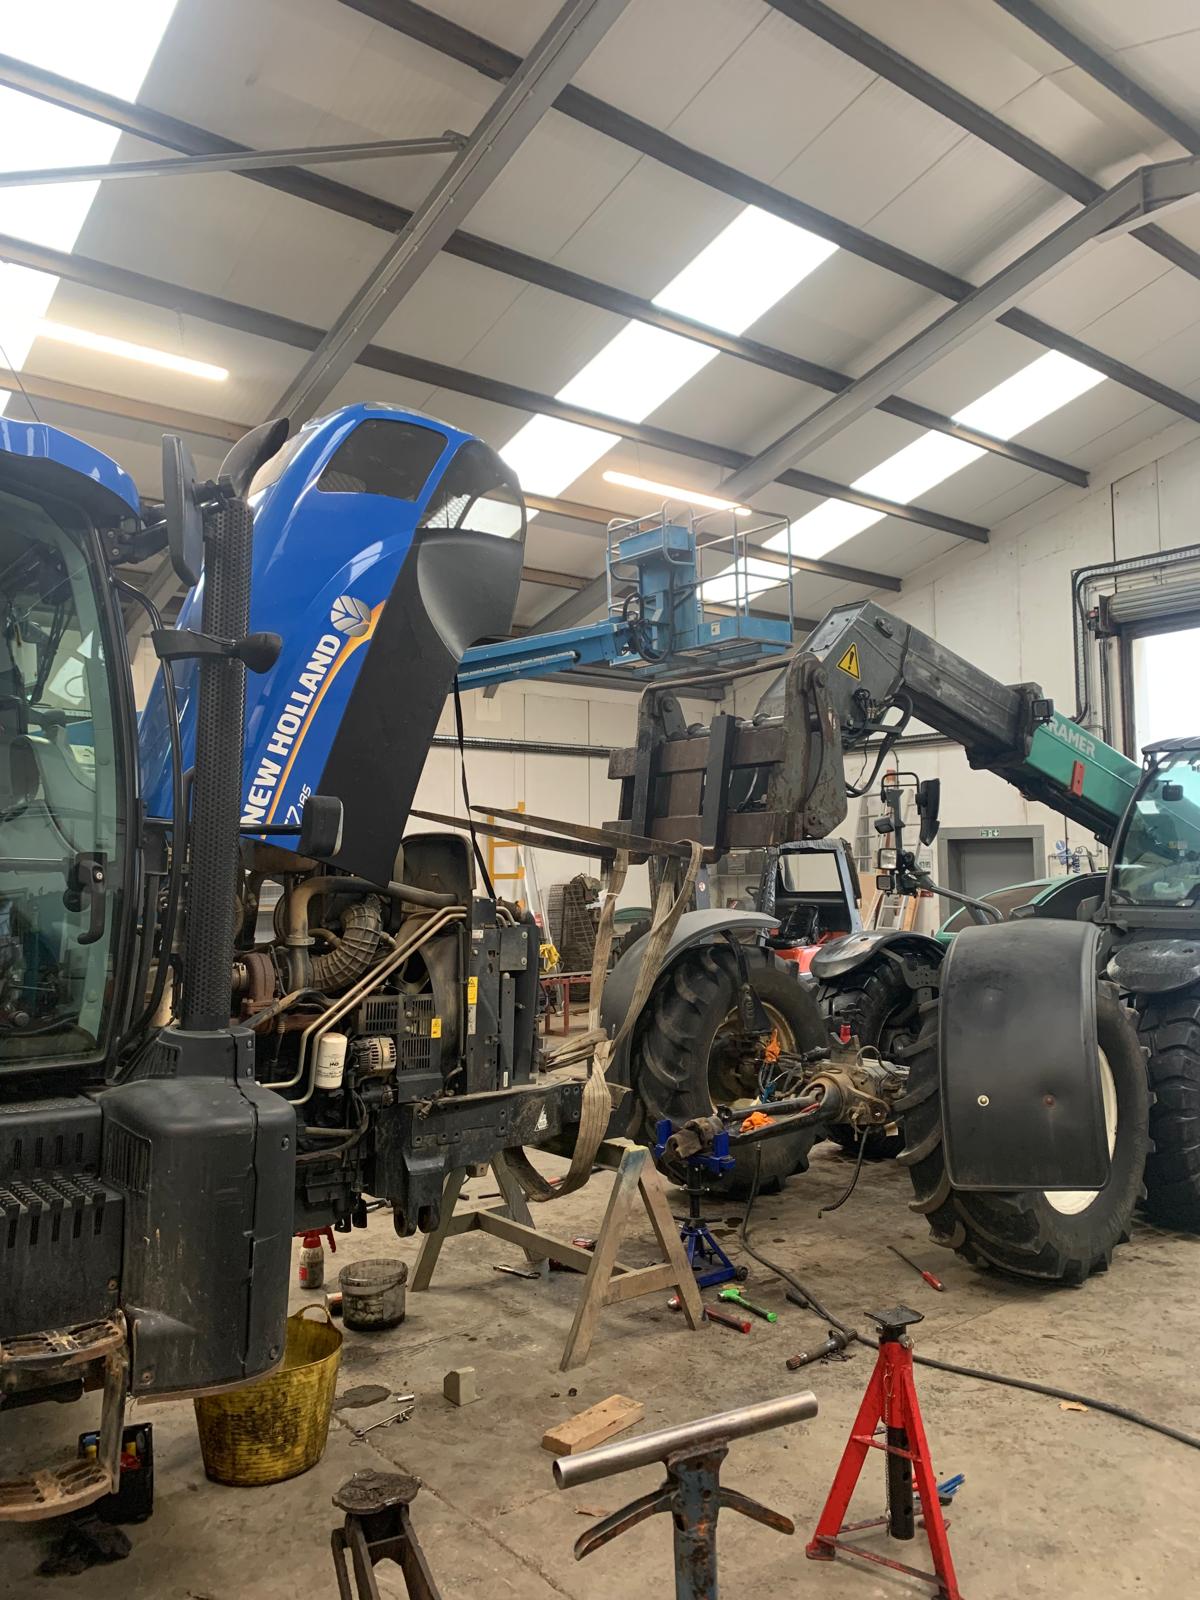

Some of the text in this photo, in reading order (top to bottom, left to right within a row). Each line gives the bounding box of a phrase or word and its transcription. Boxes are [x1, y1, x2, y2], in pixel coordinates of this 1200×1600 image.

[240, 634, 341, 824] NEW HOLLAND
[1043, 717, 1096, 760] RAMER
